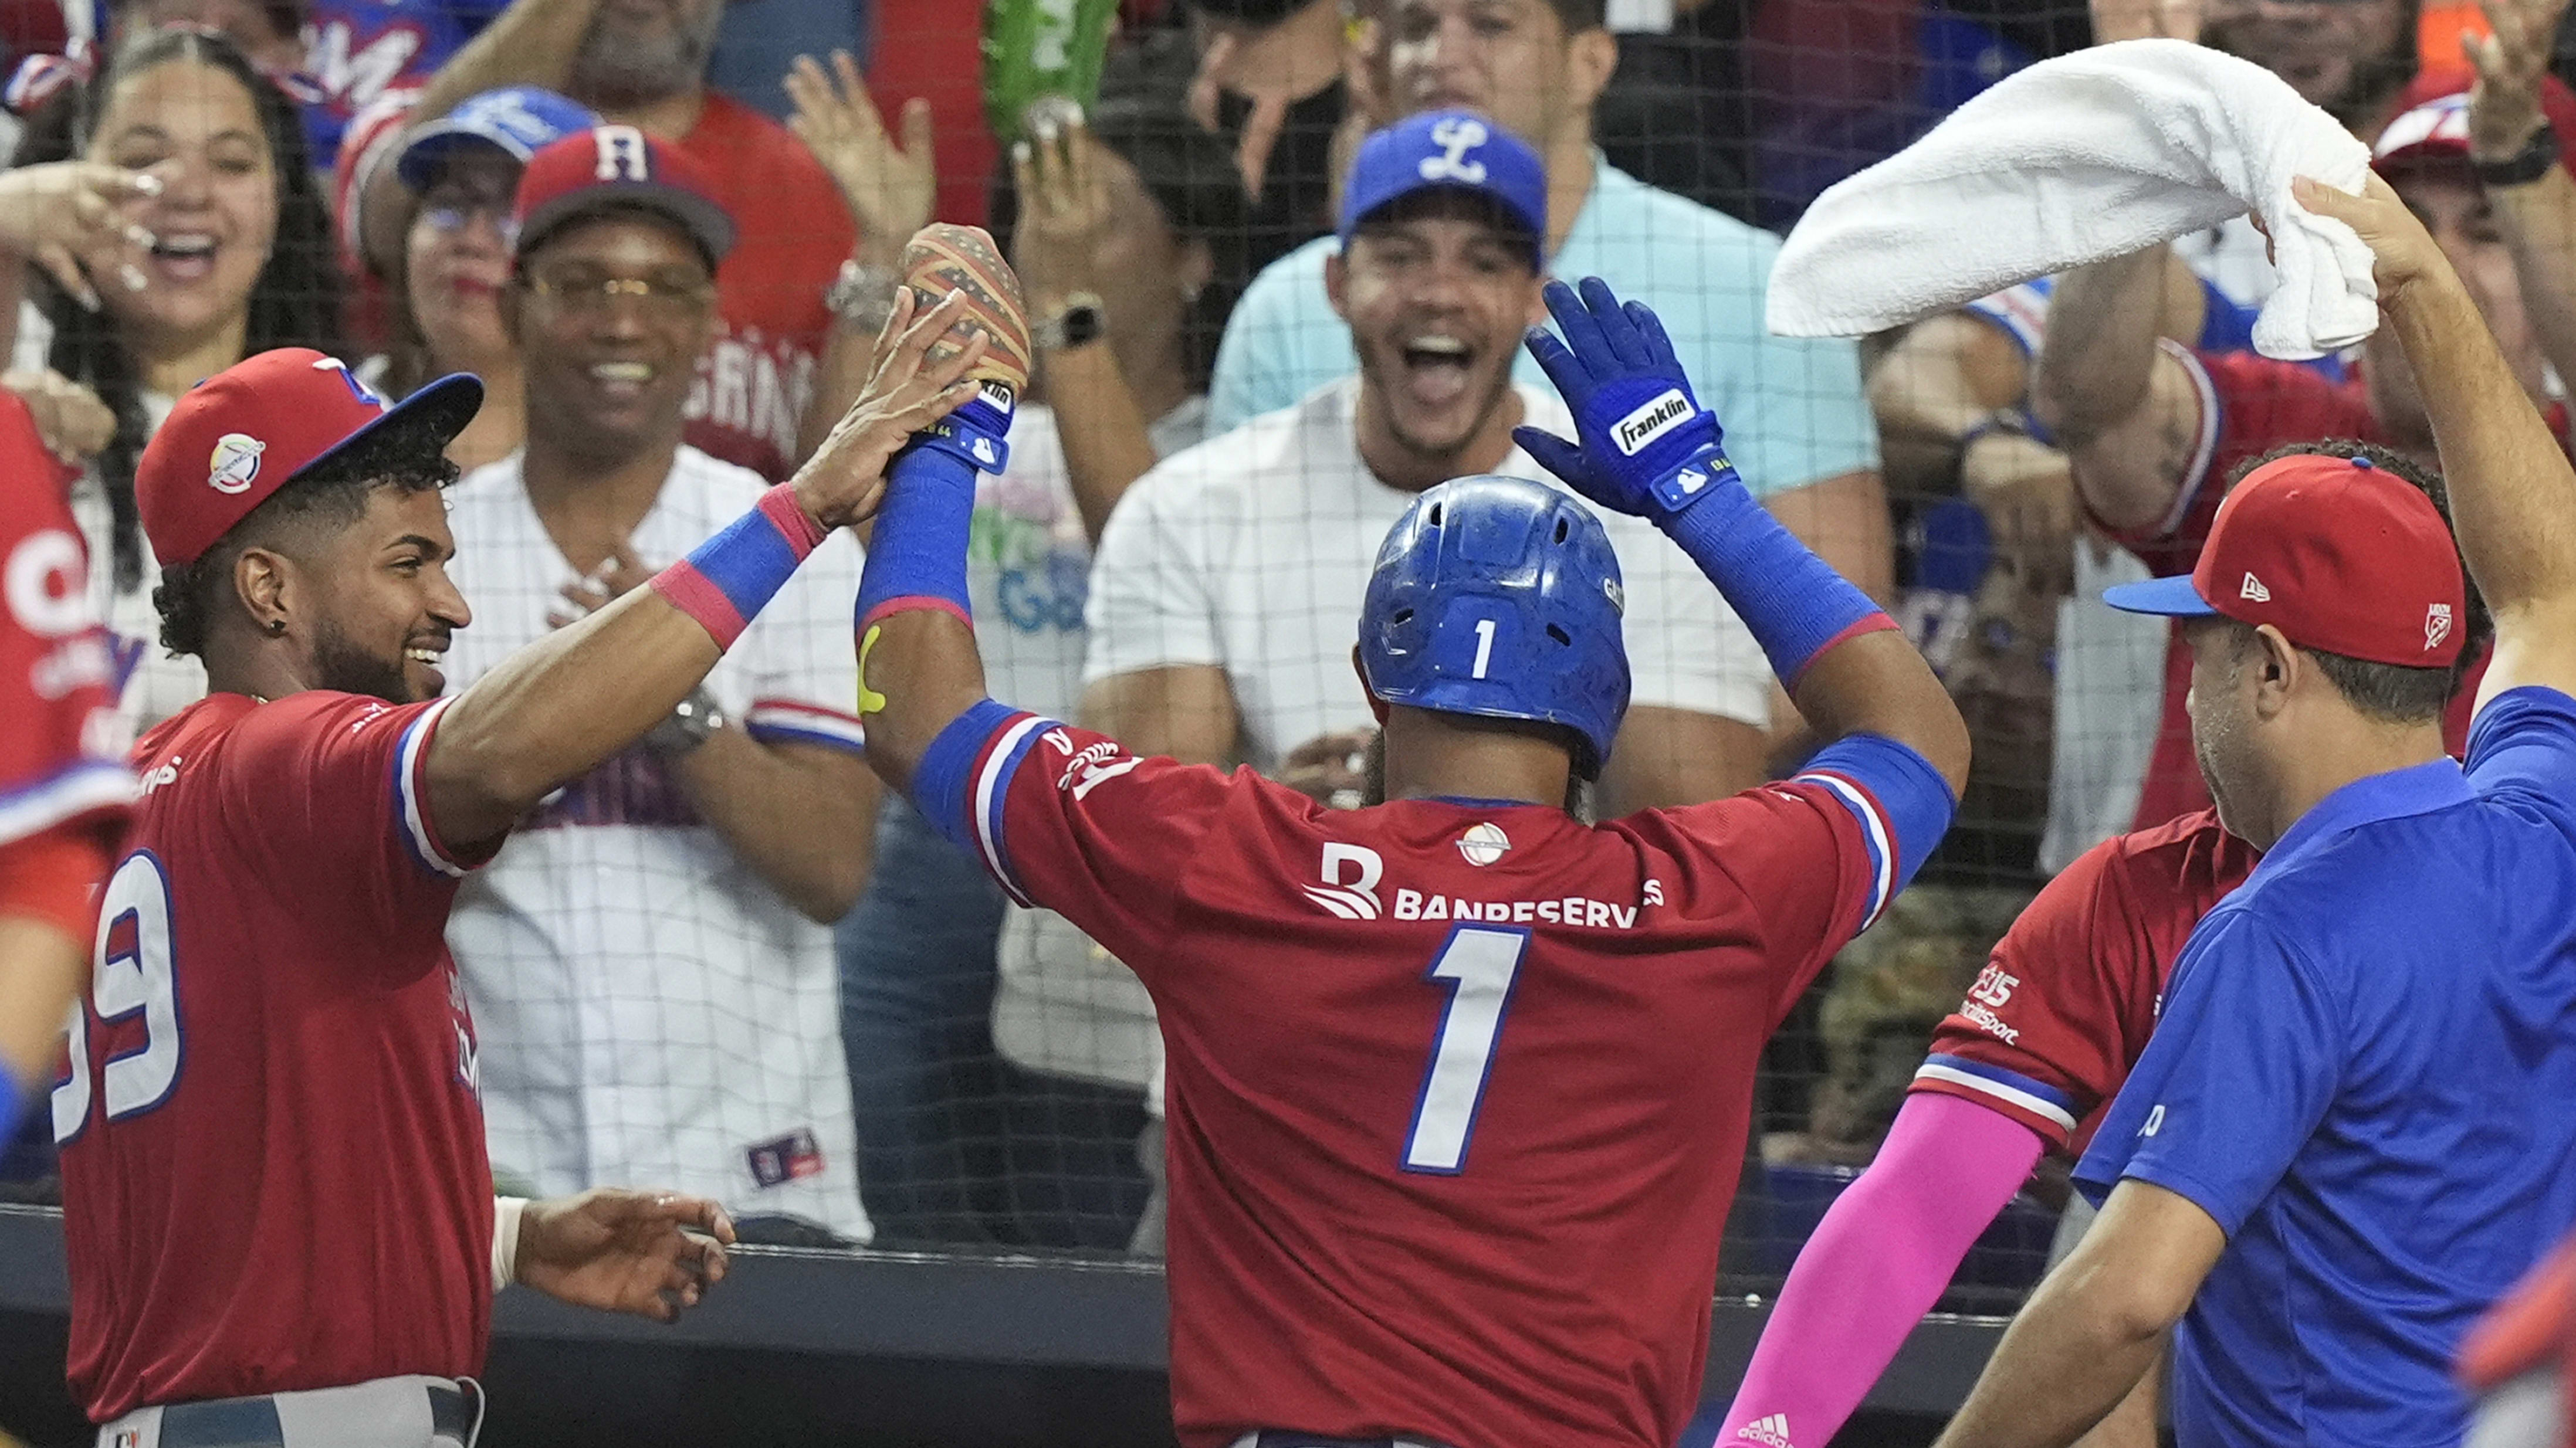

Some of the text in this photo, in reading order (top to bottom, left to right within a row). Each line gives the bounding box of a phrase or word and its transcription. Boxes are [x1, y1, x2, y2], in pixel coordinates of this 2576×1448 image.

[1473, 620, 1495, 679] 1
[1393, 879, 1664, 929] BANRESERVS
[1407, 928, 1524, 1169] 1
